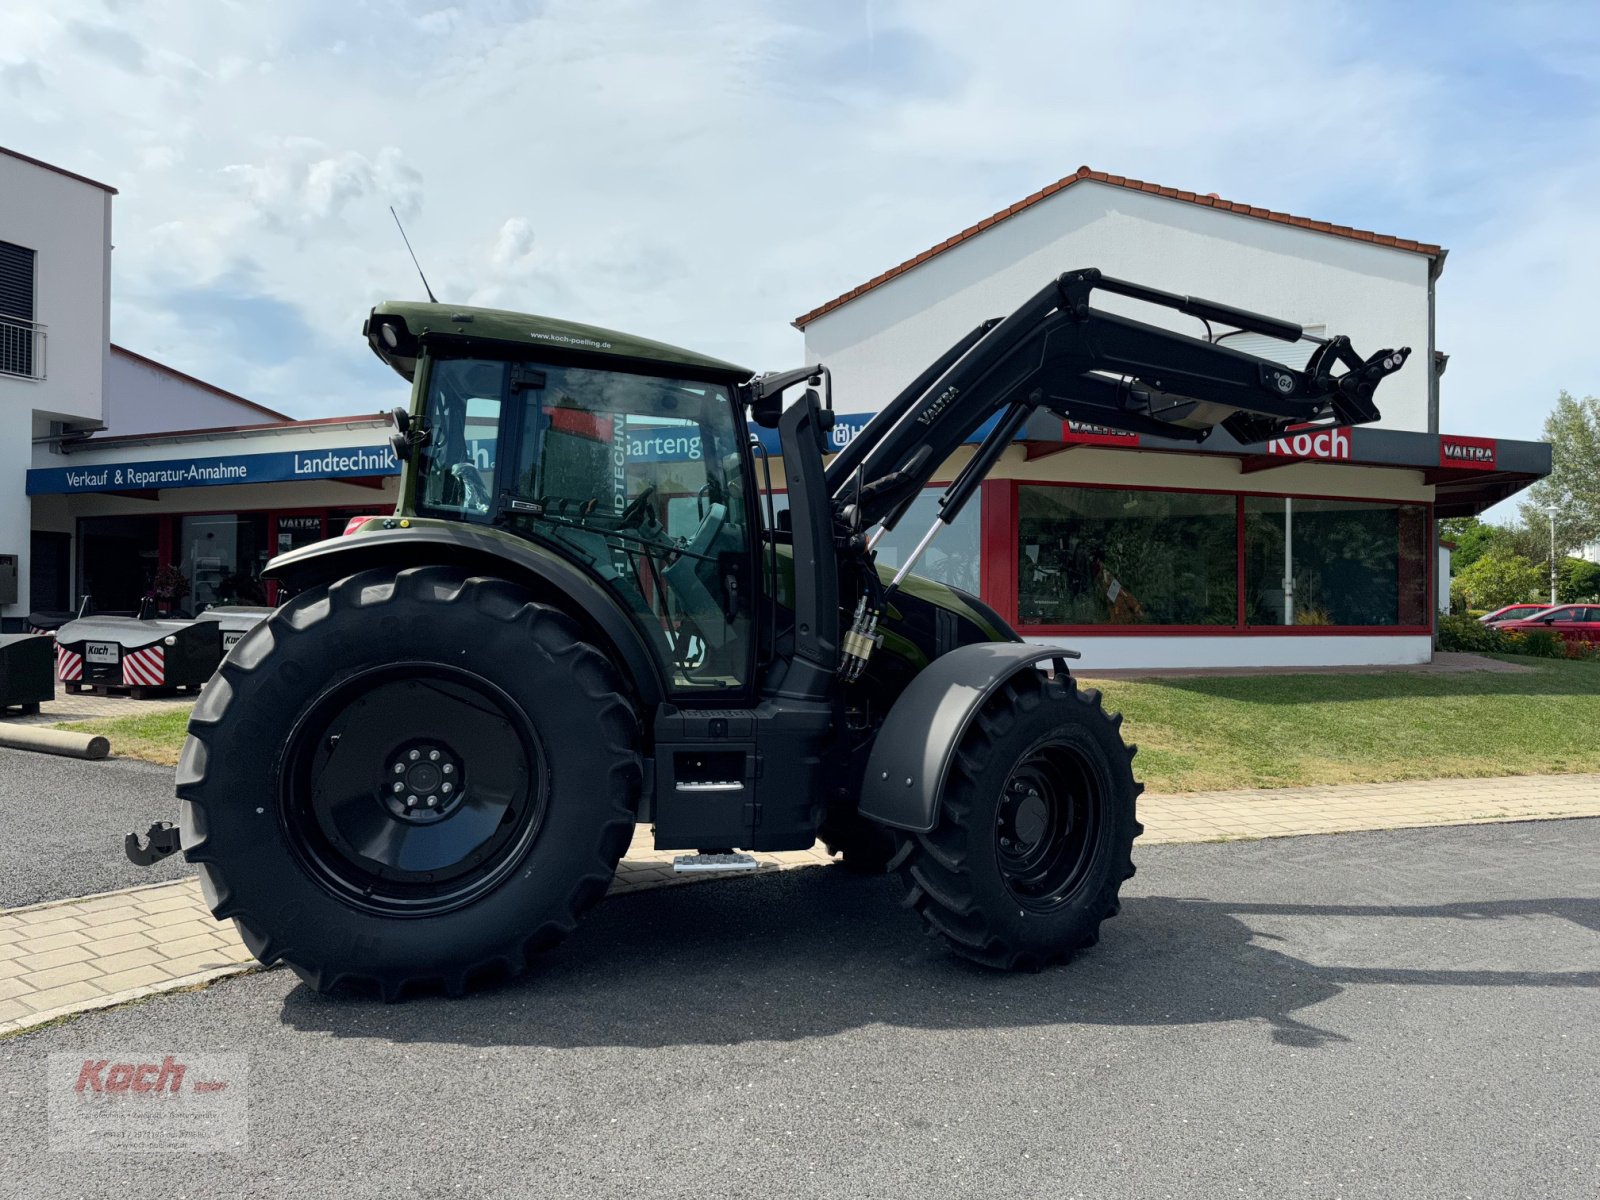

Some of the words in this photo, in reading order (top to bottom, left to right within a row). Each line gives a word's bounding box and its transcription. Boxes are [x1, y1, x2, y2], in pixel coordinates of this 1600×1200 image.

[530, 332, 612, 349] www.koch-poelling.de
[917, 386, 959, 425] VALTRA
[294, 448, 396, 474] Landtechnik
[1443, 444, 1493, 462] VALTRA
[66, 470, 108, 487] Verkauf
[114, 469, 124, 484] &
[127, 462, 247, 487] Reparatur-Annahme
[279, 518, 320, 530] VALTRA
